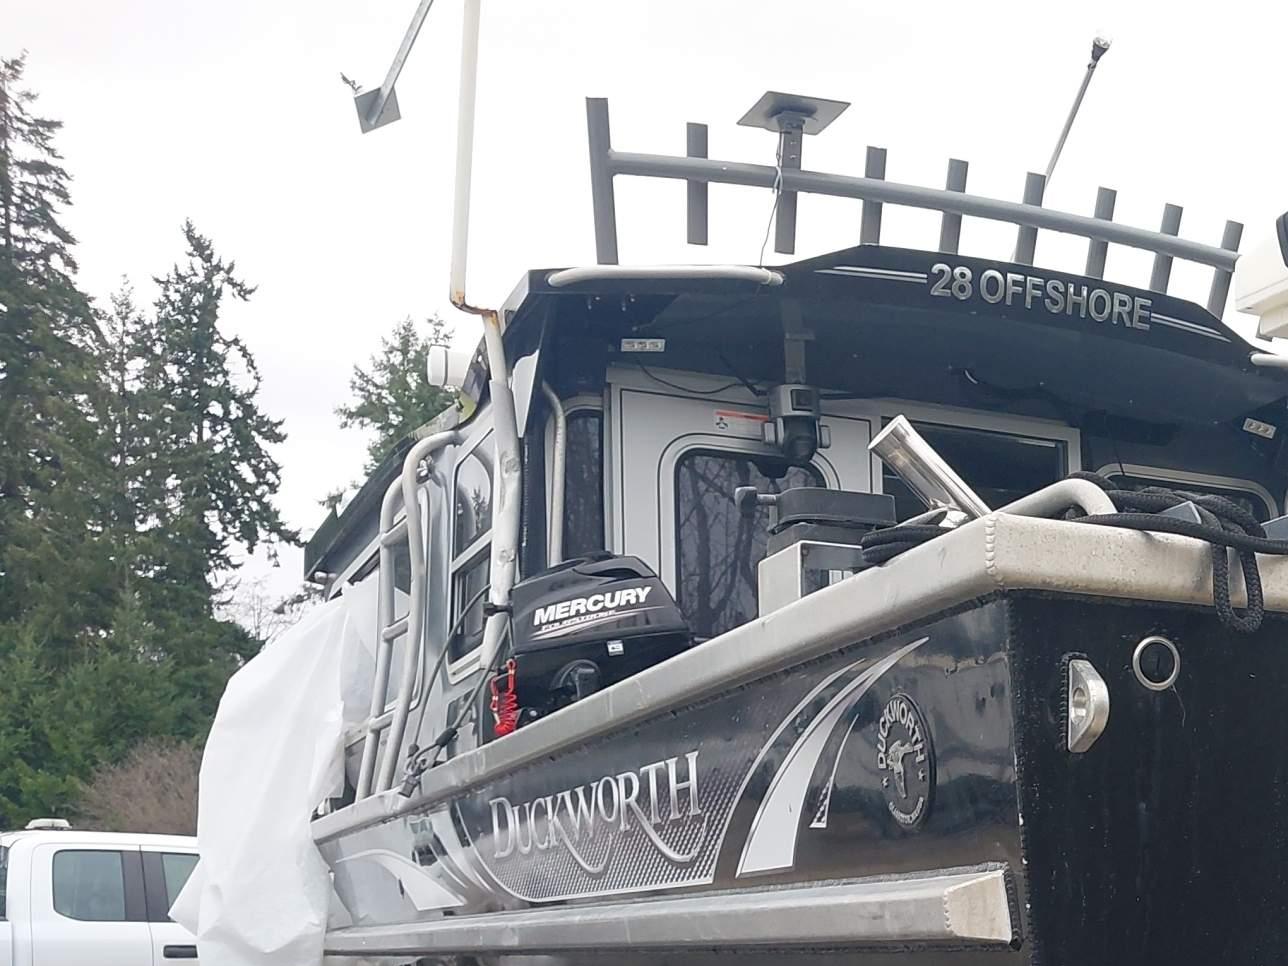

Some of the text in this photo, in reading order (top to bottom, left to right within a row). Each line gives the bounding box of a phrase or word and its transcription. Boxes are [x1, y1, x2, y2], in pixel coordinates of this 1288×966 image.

[930, 263, 1152, 331] 28 OFFSHORE
[534, 586, 652, 626] MERCURY
[877, 700, 925, 769] DUCKWORTH
[489, 751, 708, 873] DUCKWORTH
